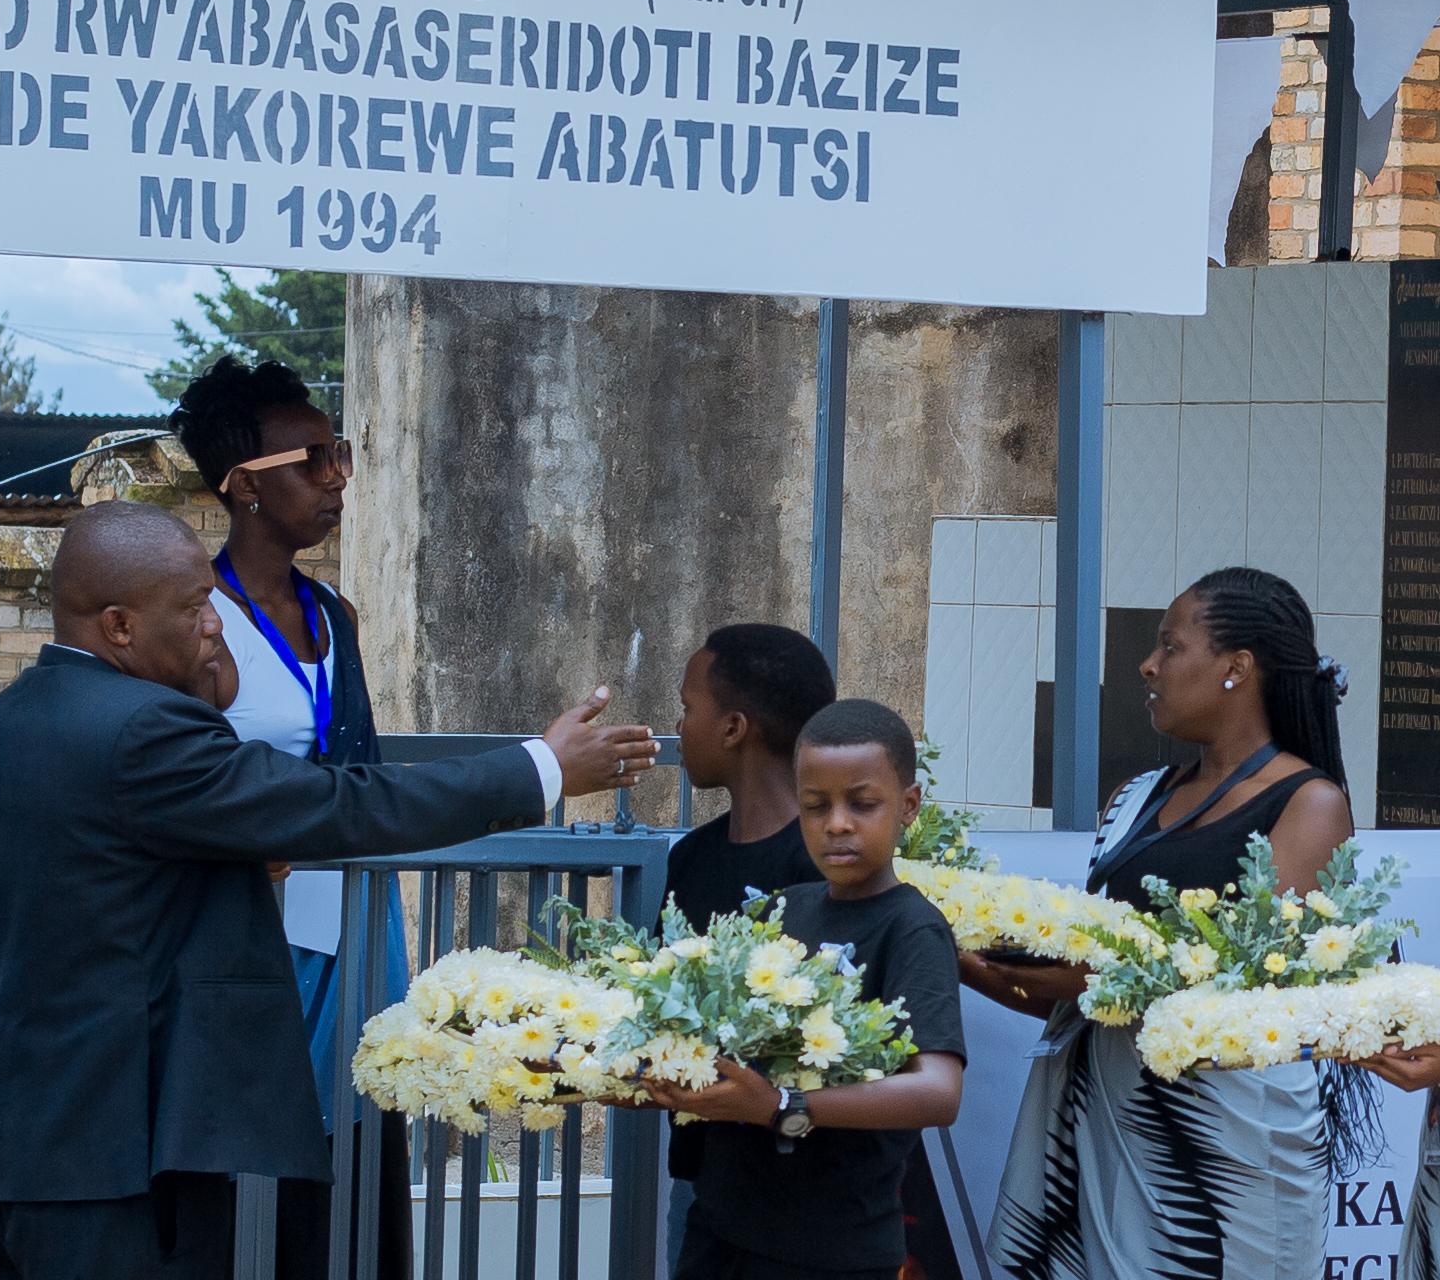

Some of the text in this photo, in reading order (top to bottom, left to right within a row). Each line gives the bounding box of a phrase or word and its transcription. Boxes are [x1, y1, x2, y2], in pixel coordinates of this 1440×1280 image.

[737, 35, 960, 117] BAZIZE
[116, 79, 515, 177] YAKOREWE
[537, 112, 870, 202] ABATUTSI
[140, 176, 440, 255] MU 1994
